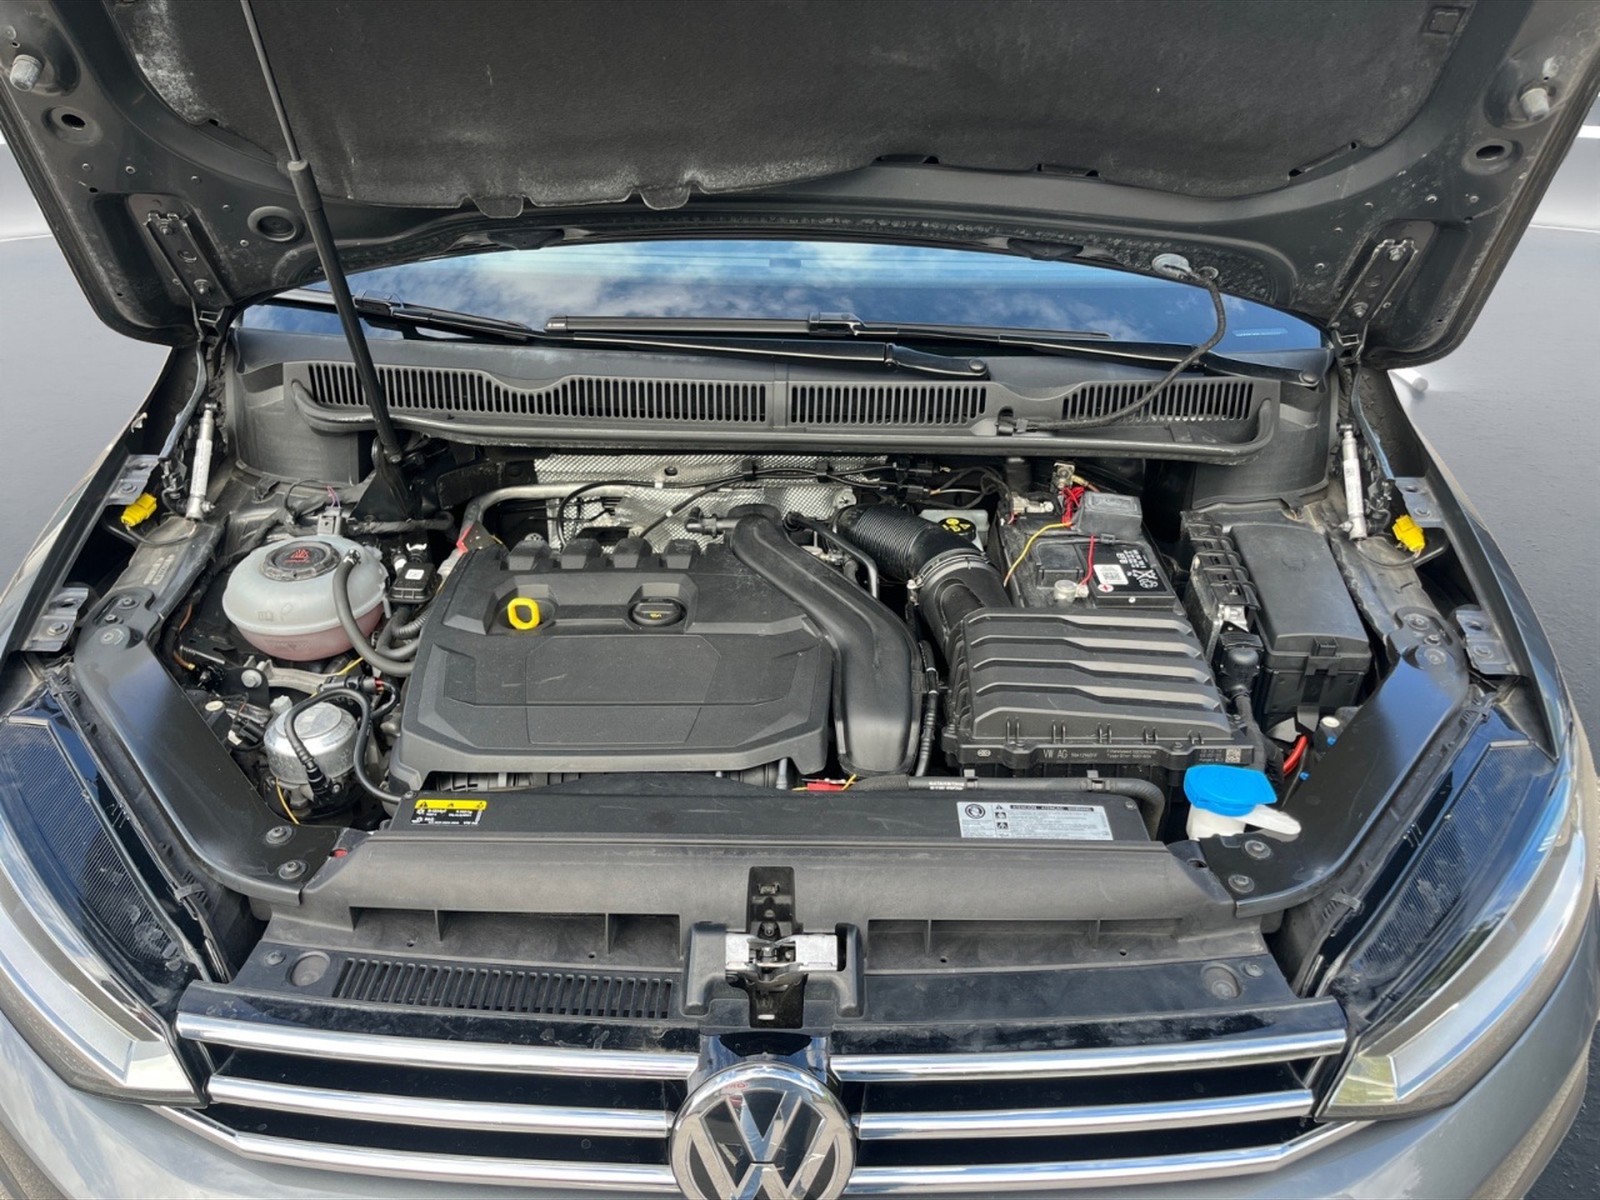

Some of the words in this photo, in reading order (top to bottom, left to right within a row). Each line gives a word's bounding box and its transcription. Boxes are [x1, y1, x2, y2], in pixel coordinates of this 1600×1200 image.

[1043, 749, 1054, 758] VW
[1057, 749, 1068, 759] AG
[684, 1084, 842, 1200] VW
